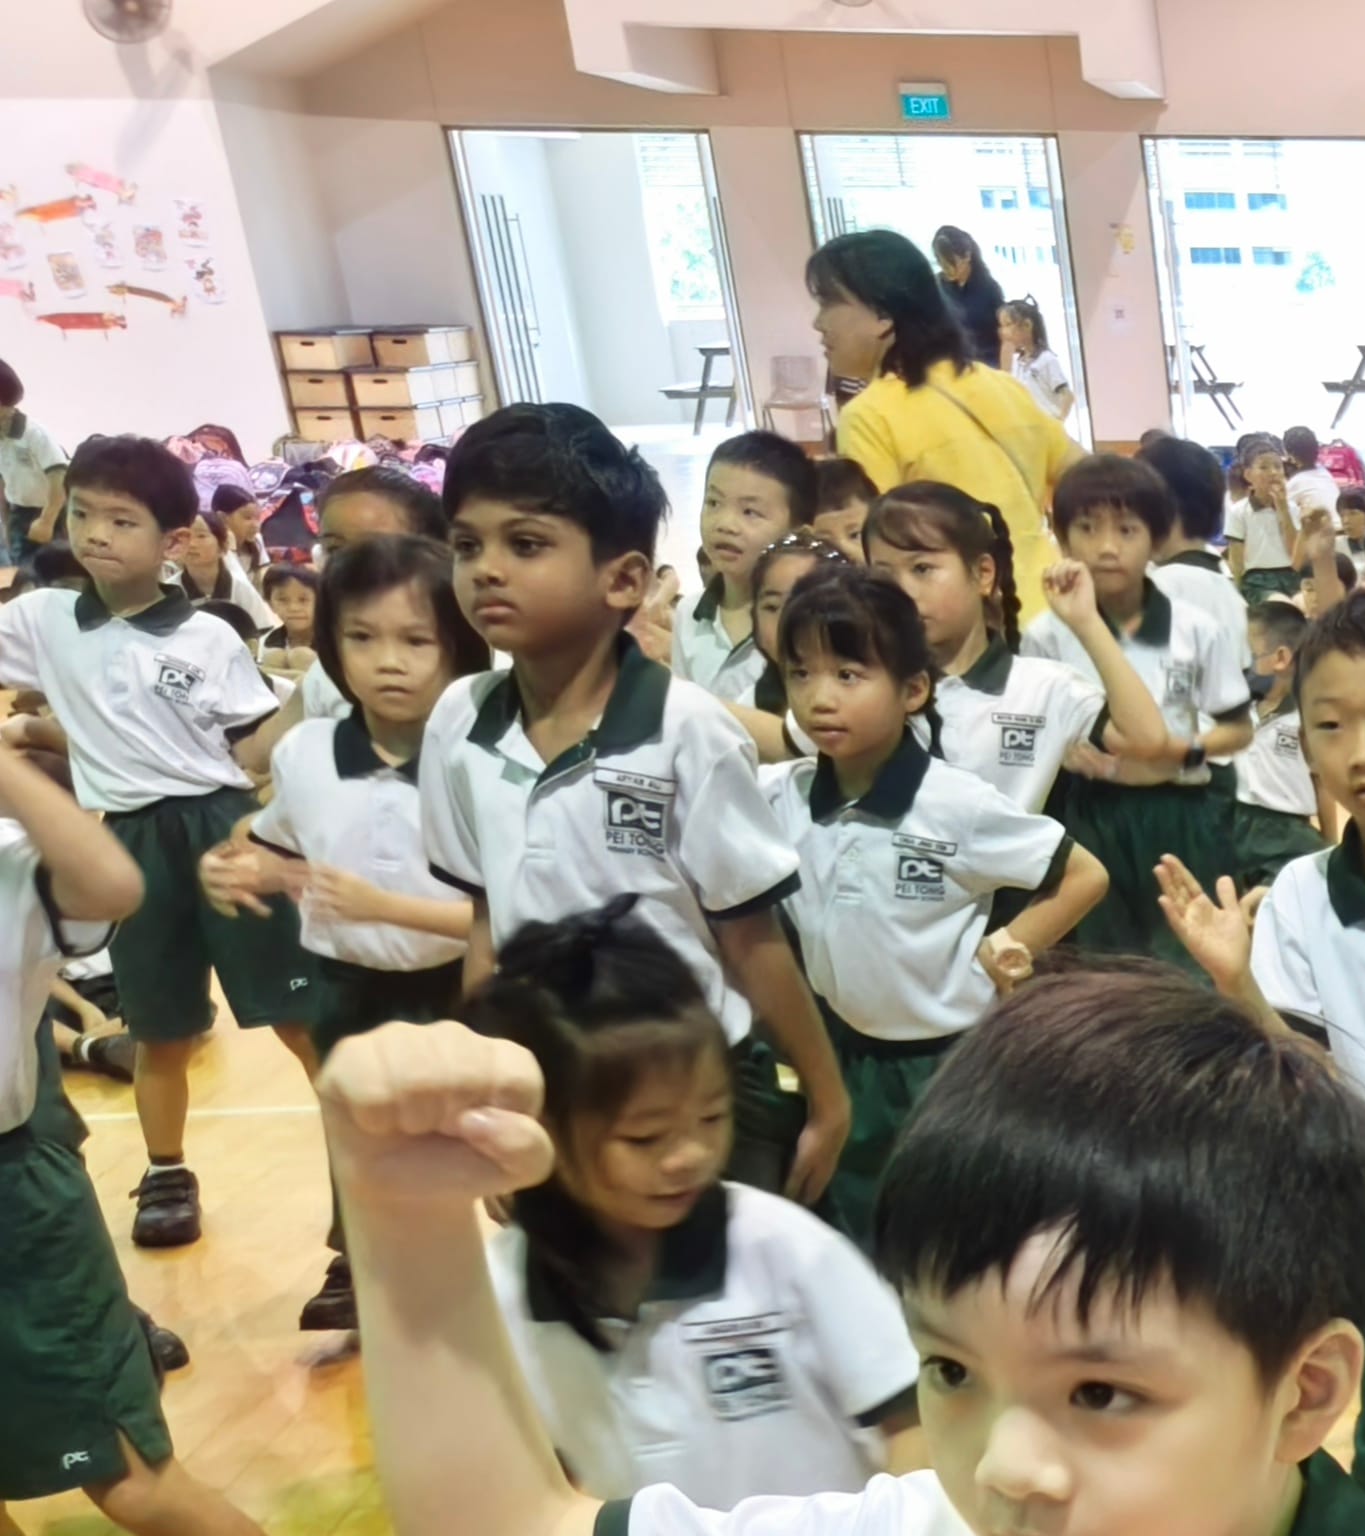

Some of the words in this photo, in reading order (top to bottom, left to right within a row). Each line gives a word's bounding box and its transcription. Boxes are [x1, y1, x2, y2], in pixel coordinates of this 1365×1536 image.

[910, 98, 939, 114] EXIT
[611, 797, 660, 829] pt
[606, 831, 624, 845] PEI
[900, 860, 940, 879] pt
